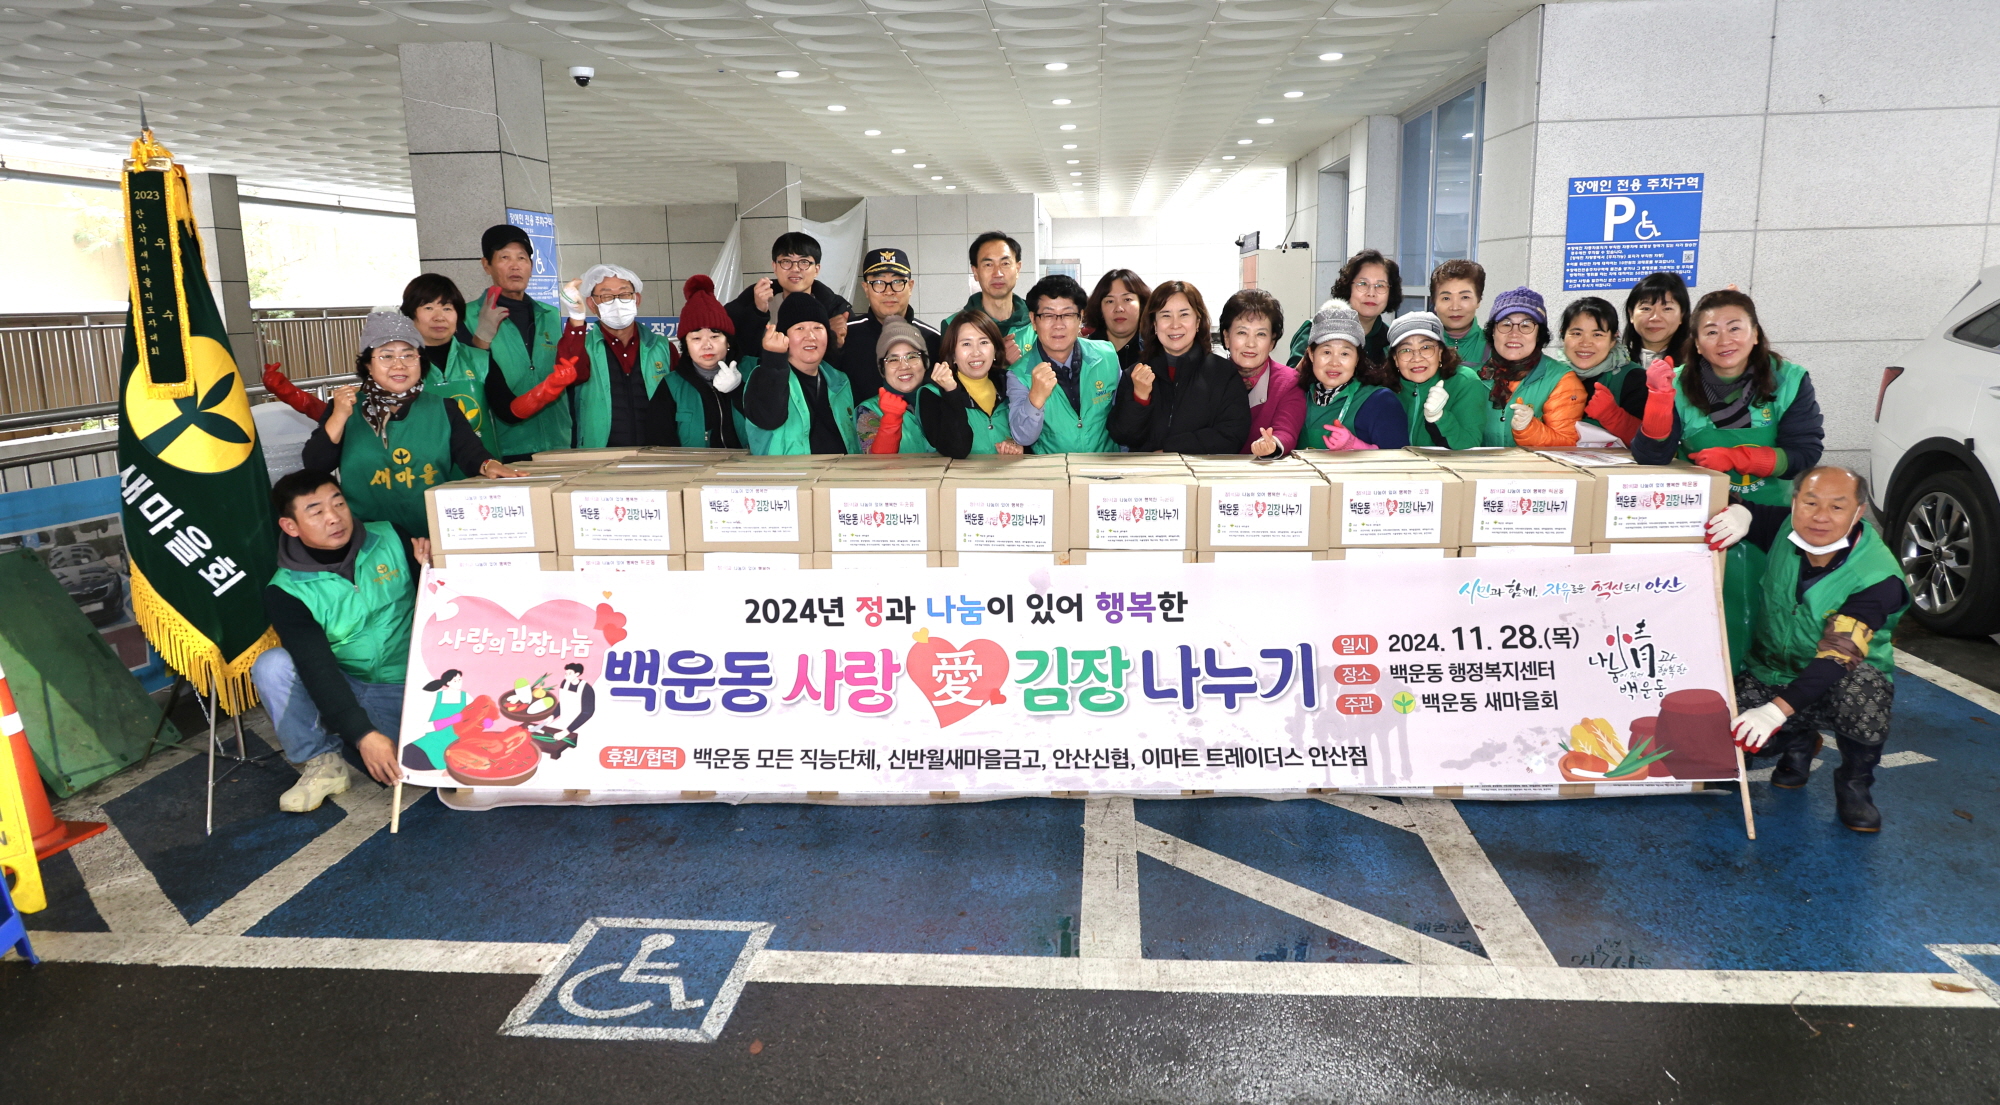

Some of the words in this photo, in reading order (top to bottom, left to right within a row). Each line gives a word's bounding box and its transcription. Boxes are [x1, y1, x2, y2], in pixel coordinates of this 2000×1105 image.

[1574, 180, 1612, 194] 장애인
[1617, 178, 1642, 192] 전용
[1647, 176, 1700, 190] 주차구역
[134, 190, 160, 200] 2023
[1604, 196, 1636, 242] P
[370, 463, 438, 490] 새마을
[709, 500, 729, 512] 백운동
[756, 500, 769, 512] 김장
[770, 500, 790, 511] 나누기
[1350, 502, 1370, 514] 백운동
[1399, 501, 1412, 513] 김장
[1413, 501, 1434, 513] 나누기
[1483, 500, 1503, 512] 백운동
[1532, 500, 1546, 512] 김장
[1547, 500, 1568, 512] 나누기
[1616, 496, 1637, 508] 백운동
[1666, 494, 1680, 506] 김장
[1681, 493, 1702, 505] 나누기
[445, 508, 465, 519] 백운동
[491, 506, 504, 518] 김장
[504, 505, 524, 517] 나누기
[580, 508, 600, 520] 백운동
[627, 508, 640, 520] 김장
[641, 509, 660, 520] 나누기
[1097, 509, 1117, 521] 백운동
[1145, 508, 1158, 520] 김장
[1159, 508, 1179, 520] 나누기
[1219, 503, 1239, 516] 백운동
[1267, 504, 1280, 516] 김장
[1282, 504, 1302, 515] 나누기
[839, 513, 858, 525] 백운동
[860, 514, 873, 525] 사랑
[886, 514, 899, 525] 김장
[899, 514, 919, 525] 나누기
[964, 513, 984, 525] 백운동
[1012, 514, 1025, 526] 김장
[1026, 514, 1045, 526] 나누기
[120, 464, 247, 598] 새마을회
[1458, 578, 1504, 604] 시민과
[1542, 582, 1586, 603] 자유로운
[1590, 580, 1640, 600] 혁신도시
[1645, 576, 1687, 594] 안산
[744, 598, 845, 627] 2024년
[855, 597, 916, 627] 정과
[926, 594, 1014, 626] 나눔이
[1026, 593, 1084, 624] 있어
[1095, 591, 1189, 624] 행복한
[1340, 637, 1370, 654] 일시
[1388, 634, 1445, 652] 2024.
[1452, 626, 1492, 650] 11.
[1500, 624, 1580, 650] 28.(목)
[604, 649, 774, 712] 백운동
[782, 649, 900, 713] 사랑
[932, 649, 985, 707] 愛
[1015, 645, 1132, 713] 김장
[1142, 643, 1316, 710] 나누기
[1342, 667, 1372, 683] 장소
[1390, 662, 1444, 684] 백운동
[1448, 660, 1556, 683] 행정복지센터
[1658, 663, 1688, 678] 행복한
[1620, 679, 1667, 700] 백운동
[1344, 696, 1374, 713] 주관
[1422, 692, 1478, 713] 백운동
[1484, 690, 1559, 711] 새마을회
[606, 748, 677, 768] 후원/협력
[694, 747, 750, 770] 백운동
[756, 748, 794, 769] 모든
[800, 748, 881, 771] 직능단체,
[888, 749, 1047, 772] 신반월새마을금고,
[1052, 748, 1136, 772] 안산신협,
[1142, 748, 1200, 770] 이마트
[1206, 746, 1304, 768] 트레이더스
[1308, 746, 1368, 767] 안산점
